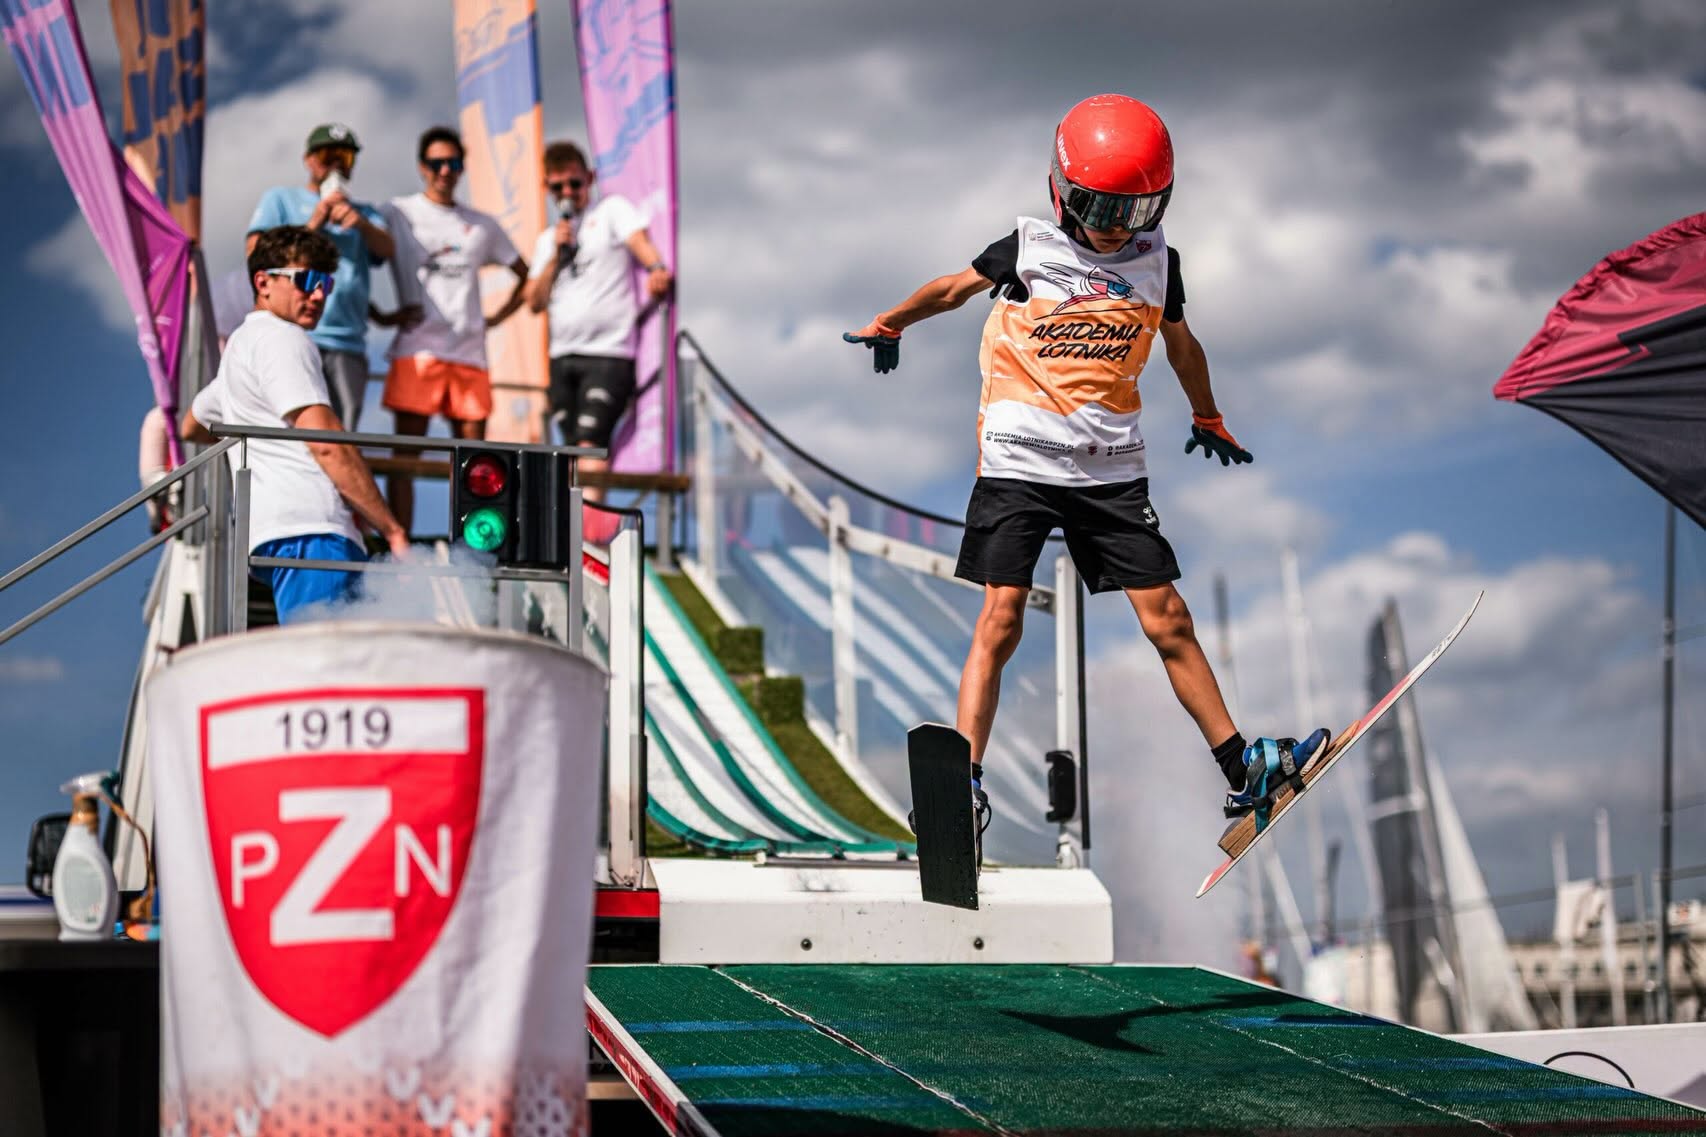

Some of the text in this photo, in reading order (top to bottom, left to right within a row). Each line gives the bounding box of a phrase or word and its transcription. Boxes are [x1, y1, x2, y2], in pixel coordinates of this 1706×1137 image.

[1058, 133, 1071, 172] uvex
[1028, 322, 1144, 342] AKADEMIA
[1037, 342, 1132, 362] LOTNIKA
[278, 706, 393, 749] 1919
